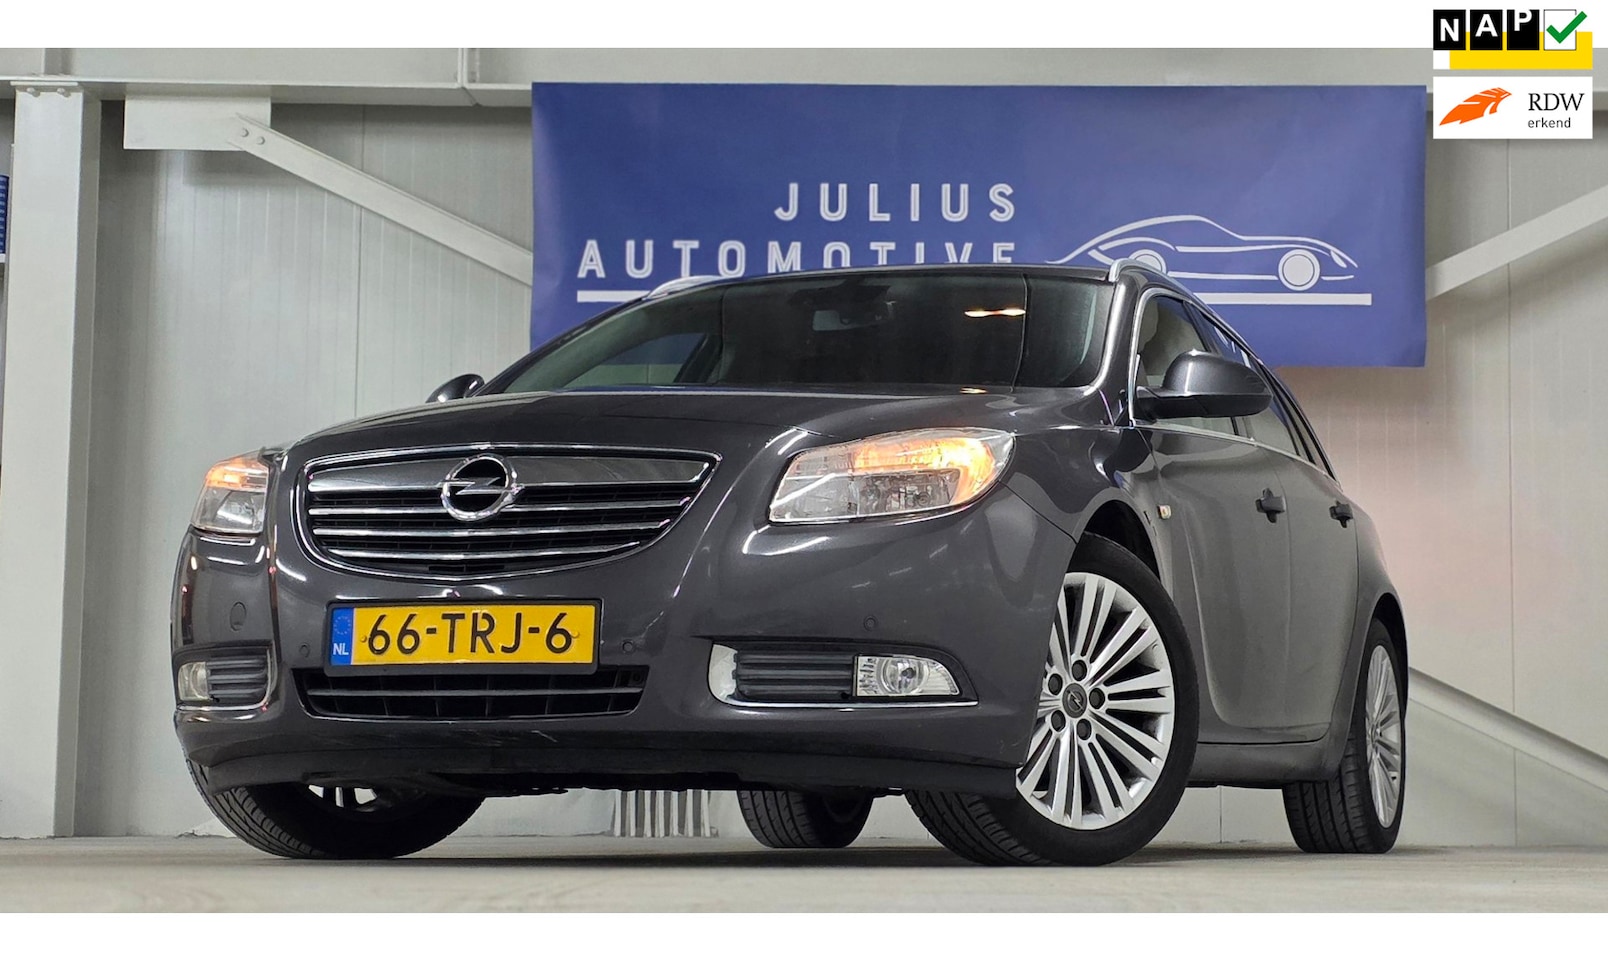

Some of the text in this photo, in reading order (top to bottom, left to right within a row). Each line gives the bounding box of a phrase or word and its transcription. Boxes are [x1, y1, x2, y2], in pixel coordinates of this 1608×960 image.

[774, 183, 1015, 222] JULIUS
[332, 612, 572, 655] NL 66-TRJ-6
